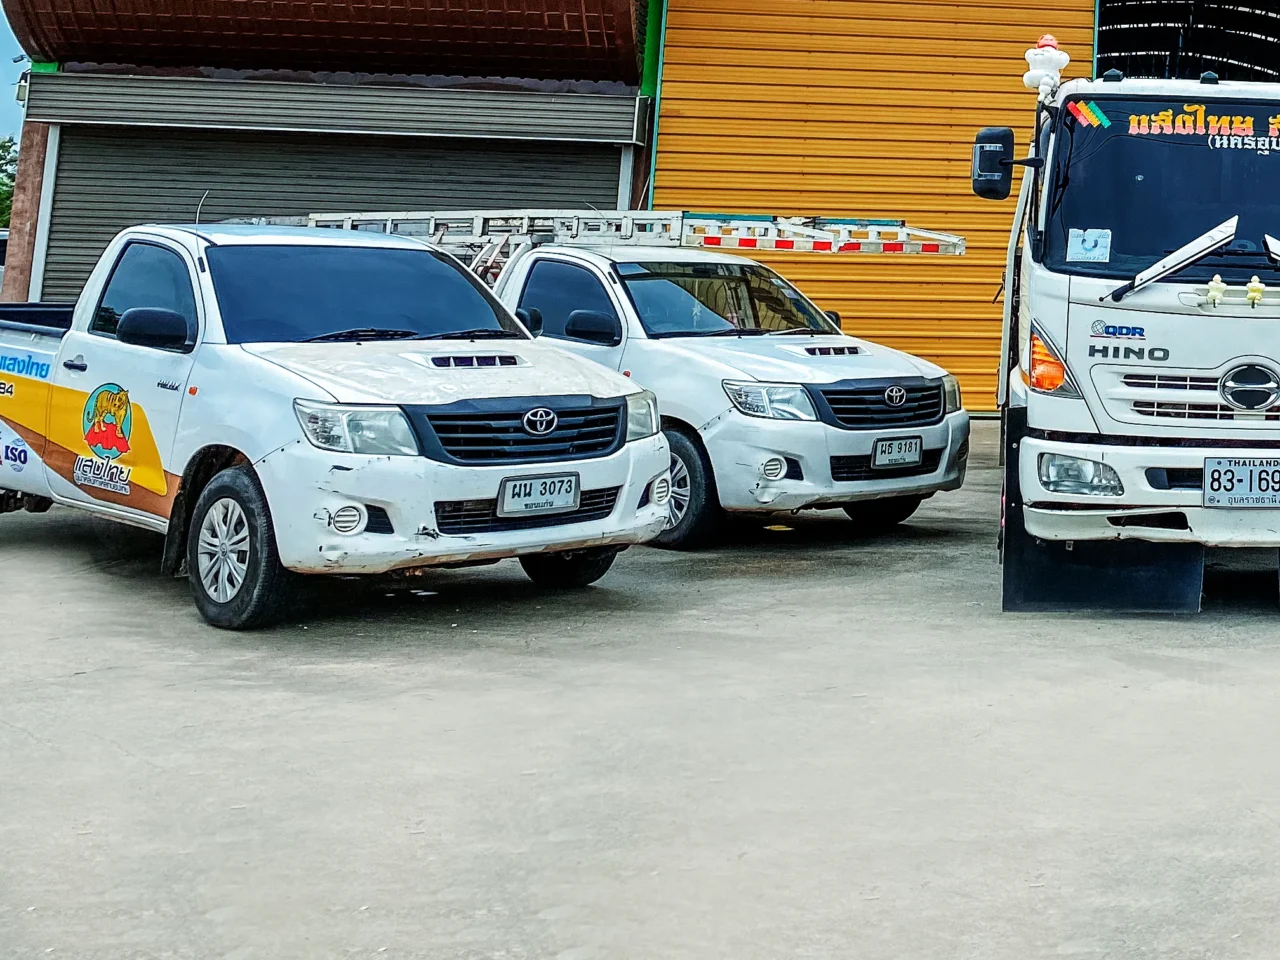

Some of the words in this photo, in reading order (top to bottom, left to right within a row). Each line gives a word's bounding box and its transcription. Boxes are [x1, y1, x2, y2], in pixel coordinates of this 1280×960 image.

[1128, 104, 1254, 136] แสงไทย
[1104, 325, 1146, 337] QDR
[1088, 345, 1170, 361] HINO
[4, 445, 28, 465] ISO
[897, 441, 918, 454] 9181
[540, 479, 573, 496] 3073
[1228, 494, 1277, 505] อุบลราชธานี
